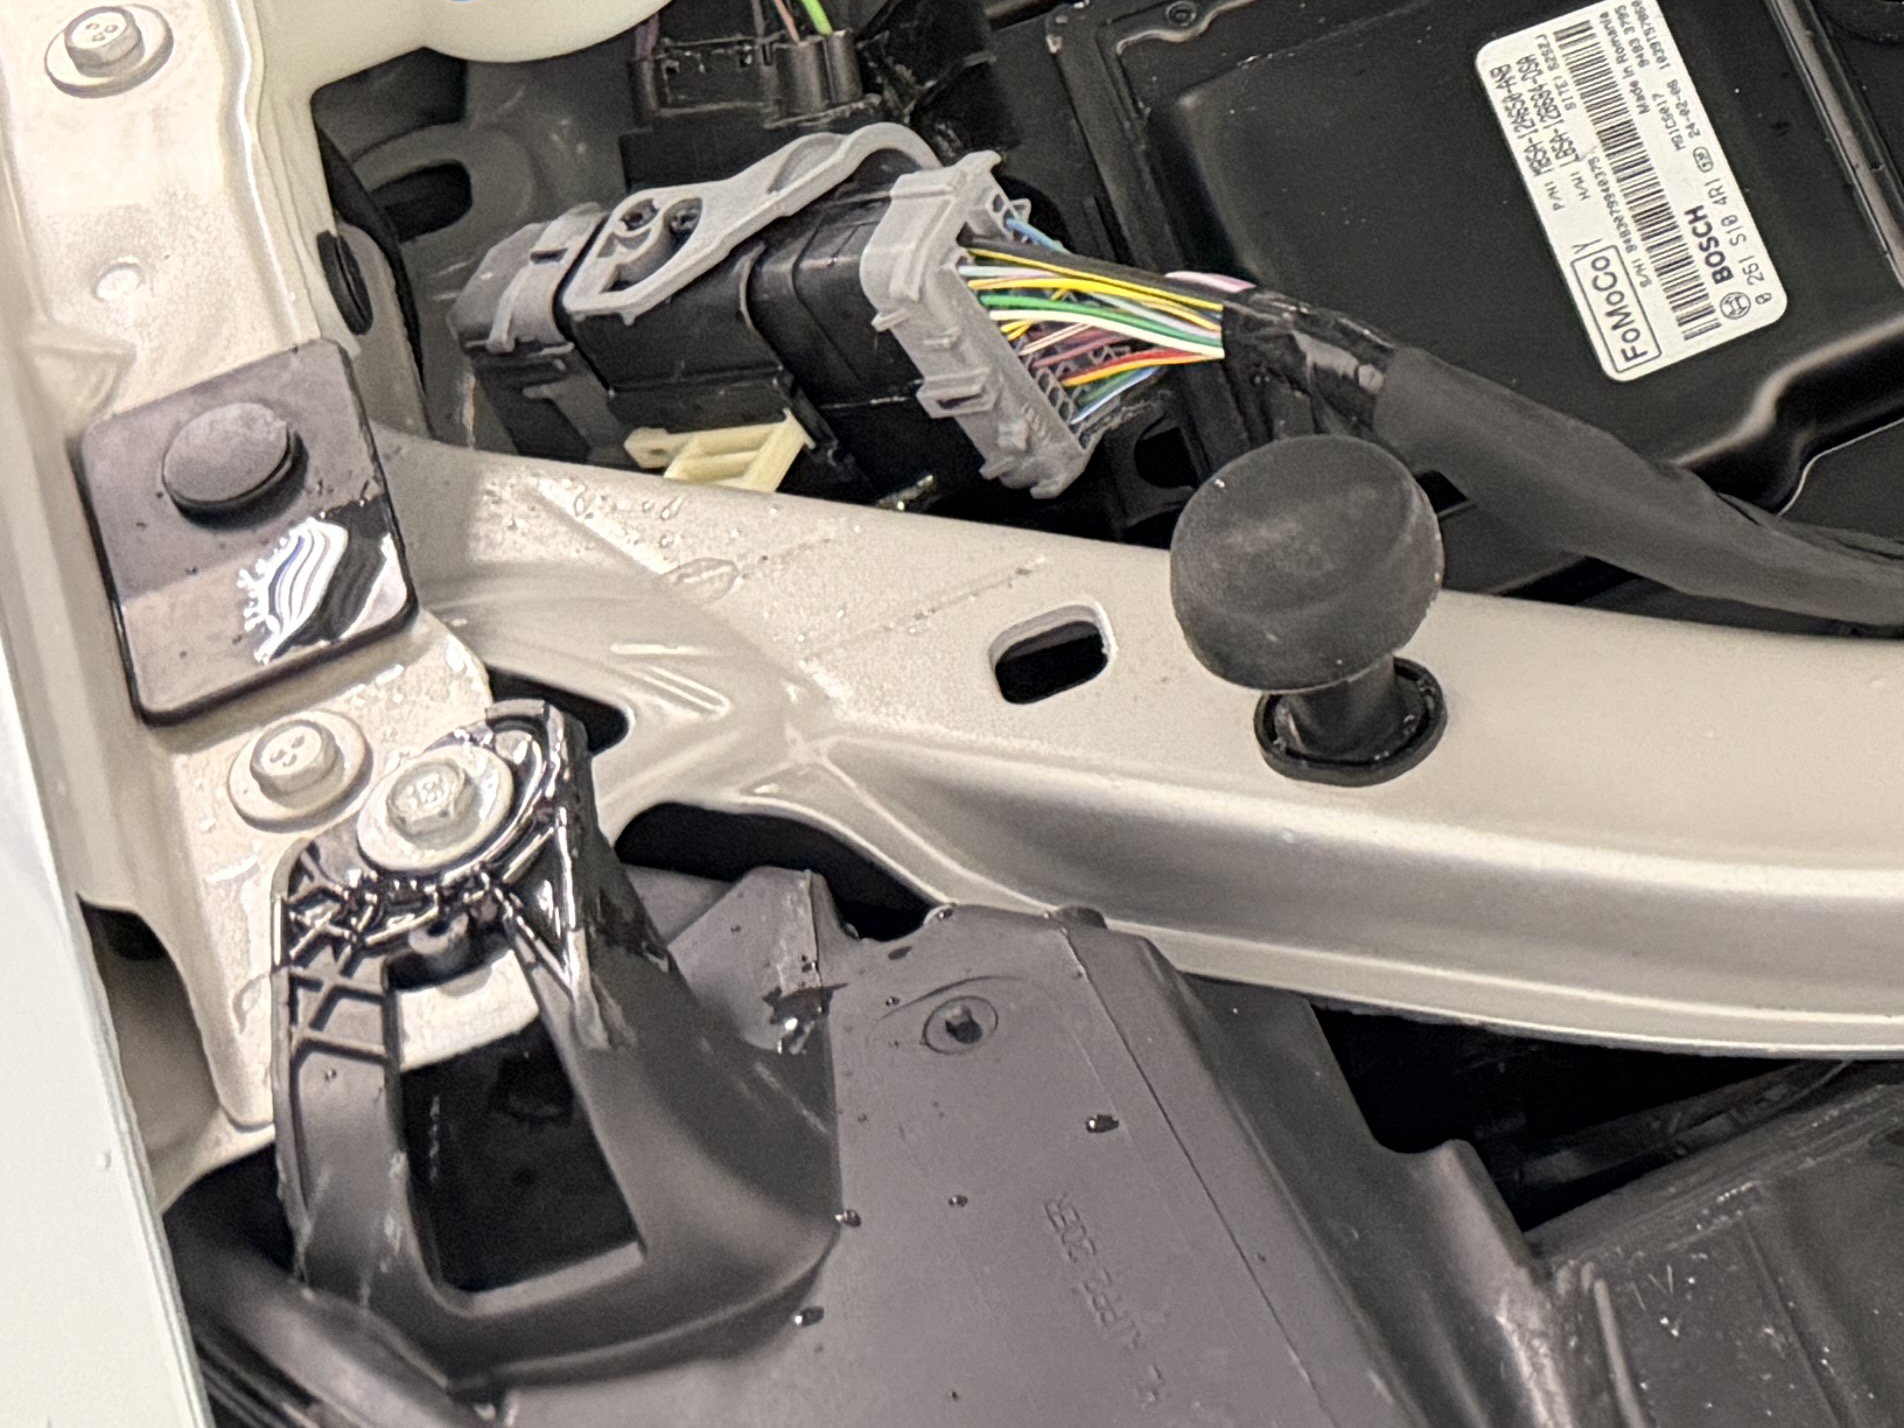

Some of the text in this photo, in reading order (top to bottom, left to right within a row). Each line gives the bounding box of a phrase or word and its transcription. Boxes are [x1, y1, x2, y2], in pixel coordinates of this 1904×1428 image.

[1599, 11, 1650, 114] Made in Romania
[1684, 204, 1733, 284] BOSCH
[1737, 255, 1765, 285] 261
[1590, 255, 1648, 362] FoMoCo
